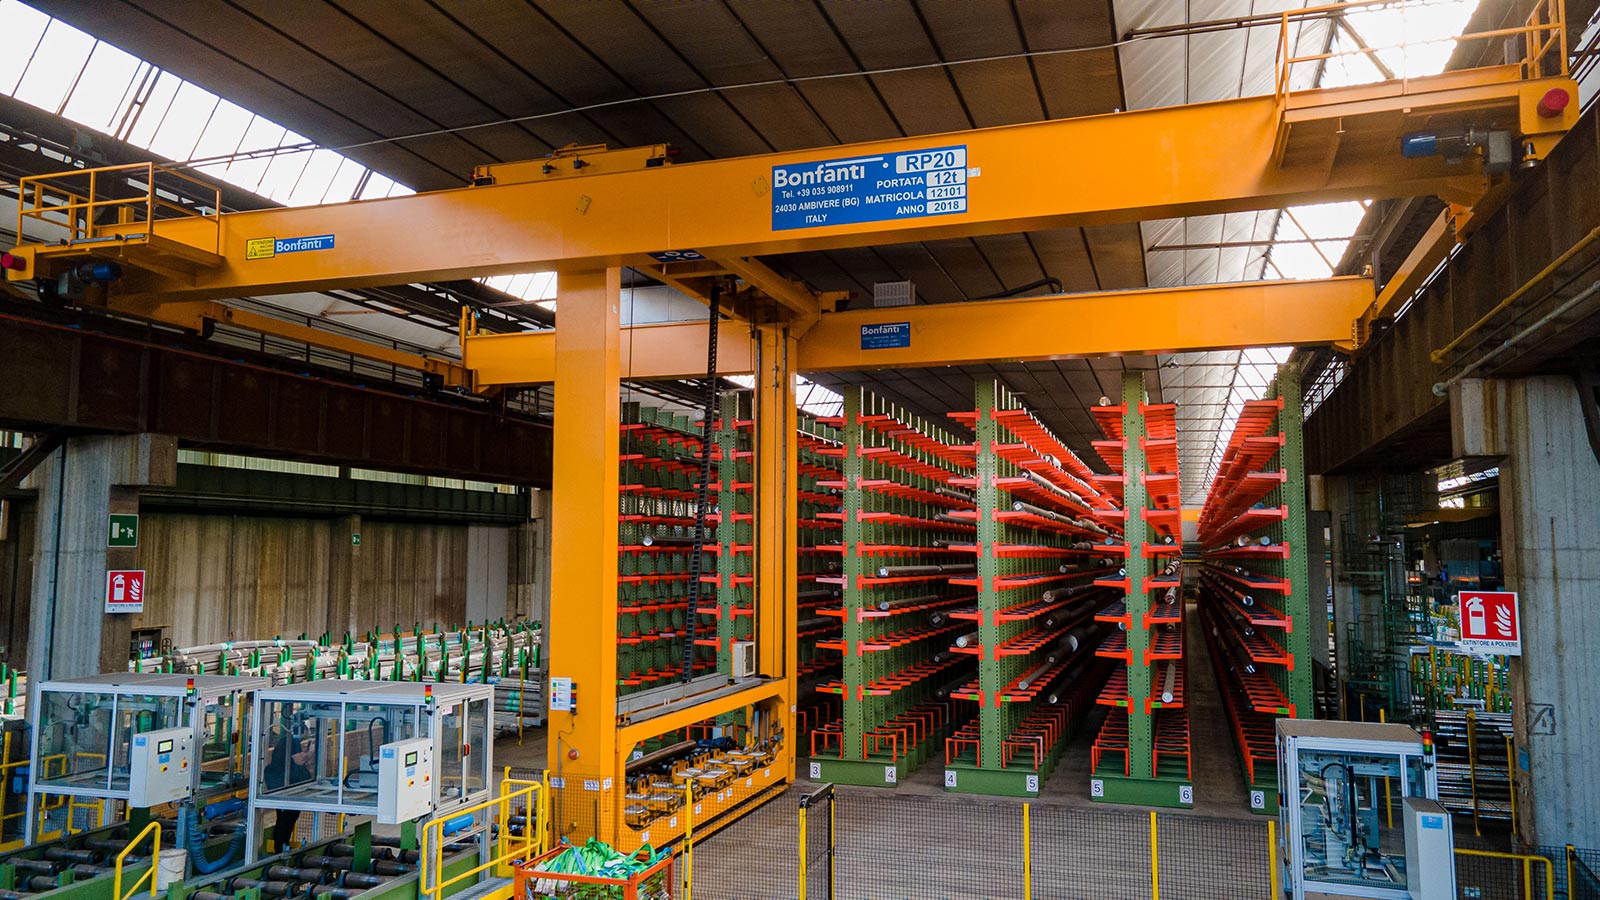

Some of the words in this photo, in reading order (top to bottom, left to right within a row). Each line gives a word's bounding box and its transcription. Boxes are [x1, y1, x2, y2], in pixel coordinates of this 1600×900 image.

[906, 152, 955, 171] RP20
[774, 164, 865, 188] Bonfanti
[876, 176, 924, 189] PORTATA
[934, 172, 957, 184] 12t
[782, 190, 794, 199] Tel.
[796, 188, 810, 197] +39
[812, 186, 826, 196] 035
[827, 184, 853, 194] 908911
[865, 190, 924, 204] MATRICOLA
[930, 186, 961, 198] 12101
[775, 204, 797, 213] 24030
[798, 199, 840, 211] AMBIVERE
[842, 197, 860, 208] (BG)
[896, 204, 924, 215] ANNO
[934, 200, 960, 212] 2018
[805, 214, 828, 223] ITALY
[276, 238, 322, 252] Bonfanti
[862, 326, 900, 335] Bonfanti
[812, 766, 818, 775] 3
[948, 774, 954, 782] 4
[1029, 779, 1036, 788] 5
[1094, 783, 1101, 792] 5
[1183, 789, 1190, 799] 6
[1254, 794, 1261, 804] 6
